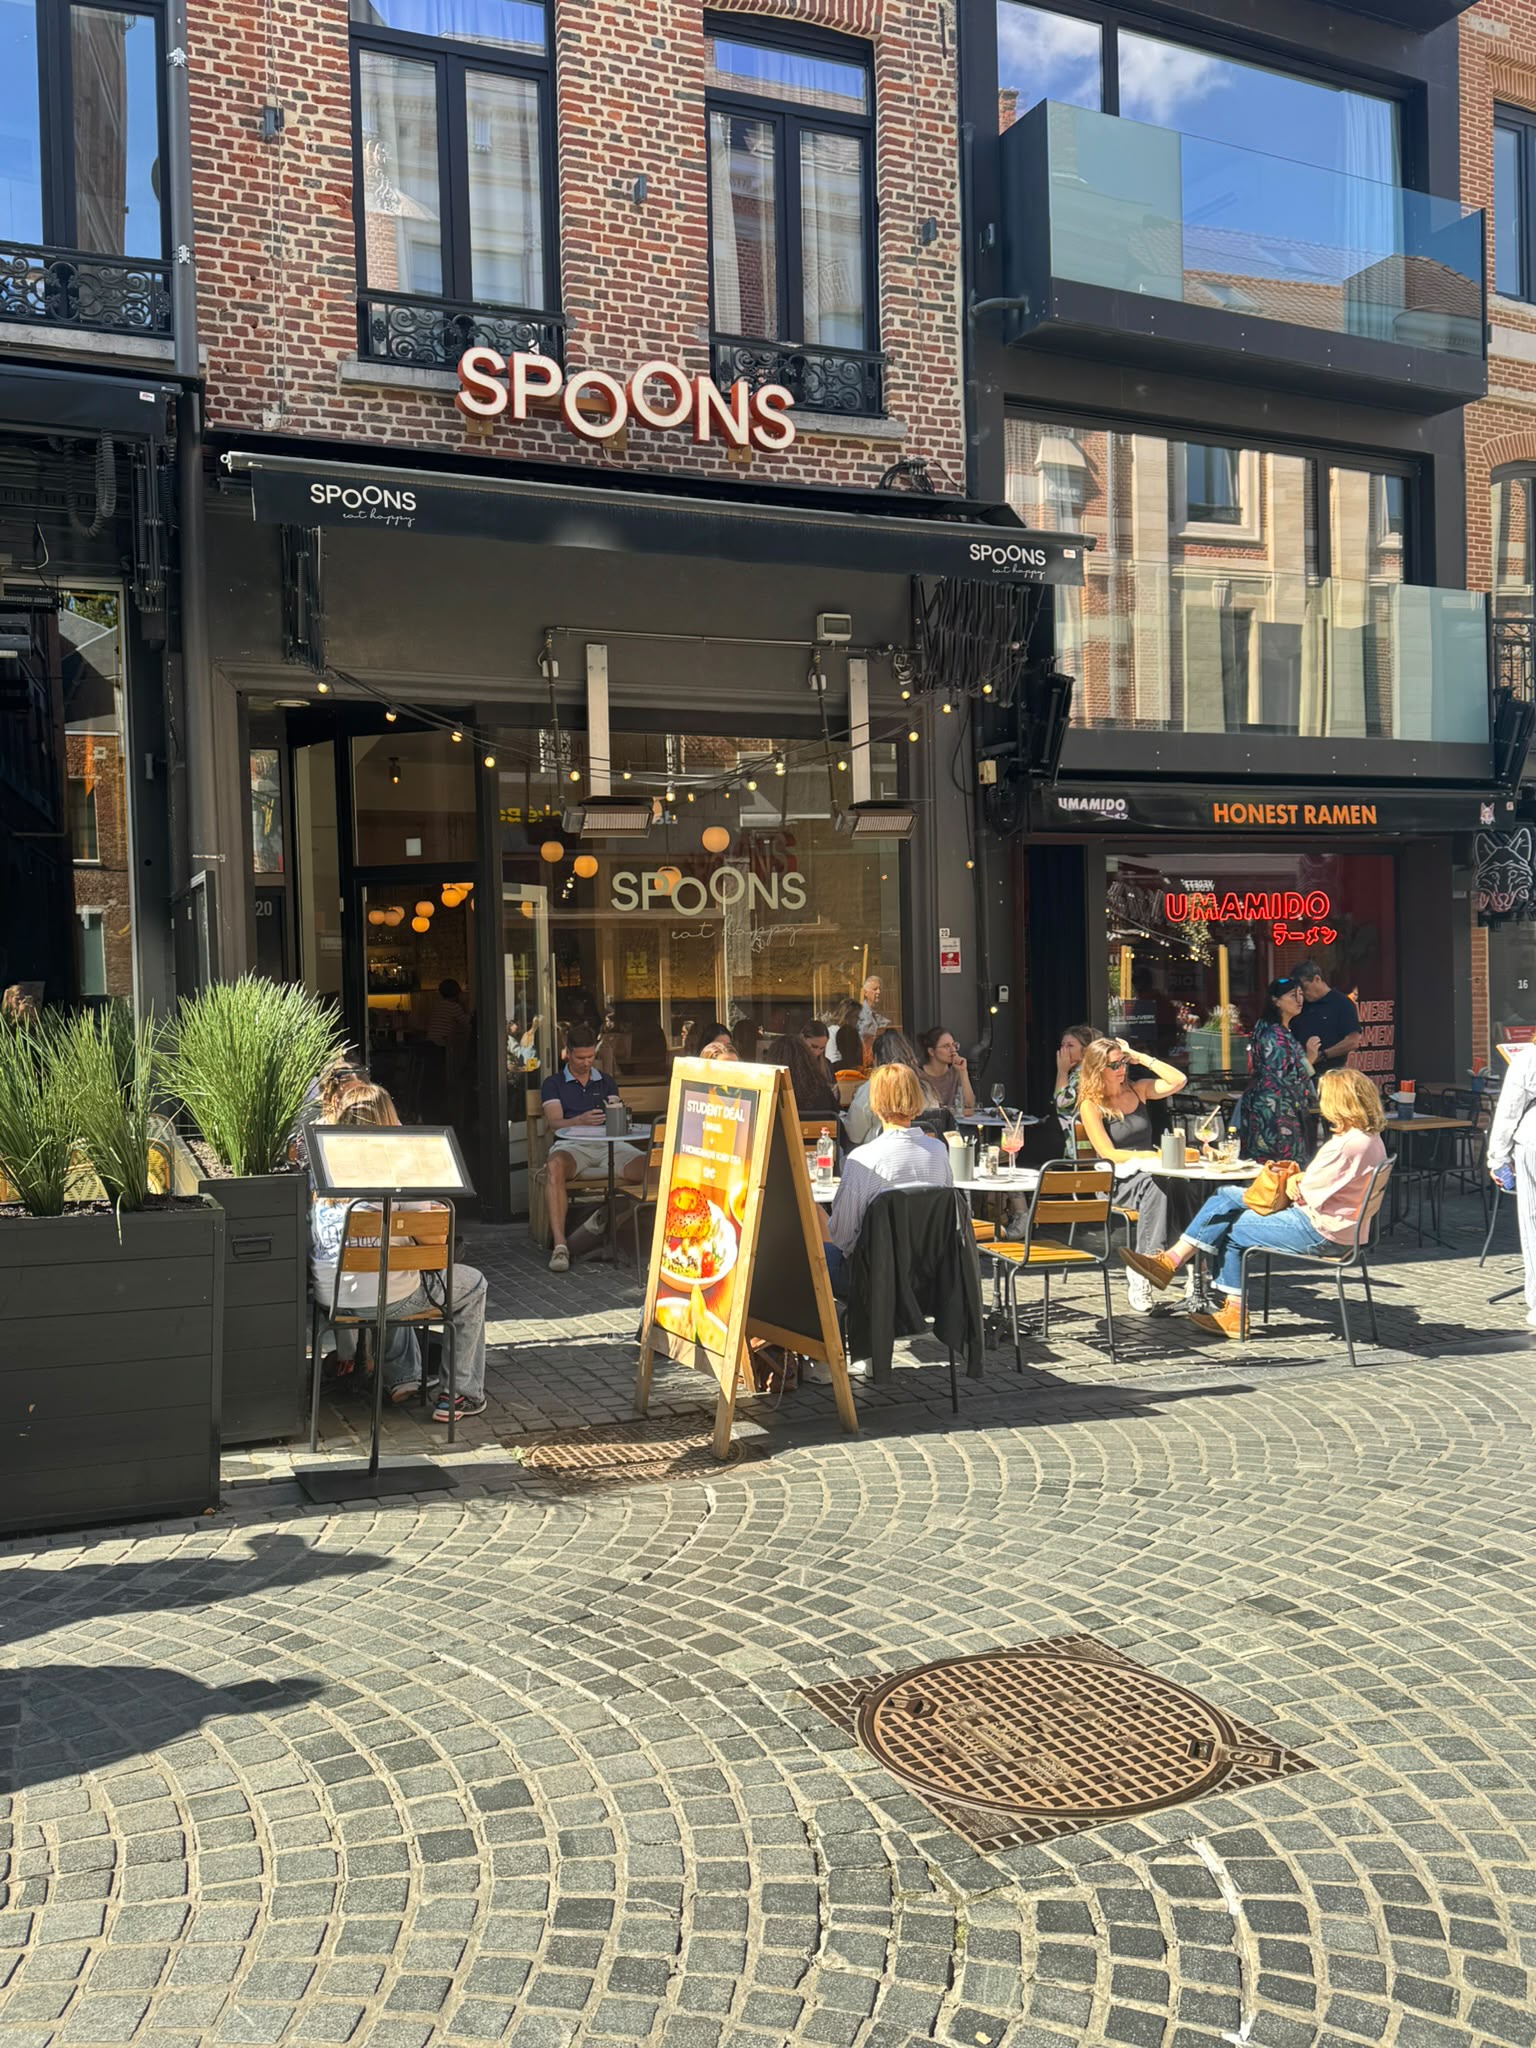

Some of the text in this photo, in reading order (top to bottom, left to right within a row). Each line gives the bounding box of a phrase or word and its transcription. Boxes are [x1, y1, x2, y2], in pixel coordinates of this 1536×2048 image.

[454, 346, 796, 453] SPOONS
[310, 483, 417, 511] SPOONS
[342, 507, 416, 528] eat happy
[969, 543, 1047, 566] SPOONS
[1057, 797, 1126, 811] UMAMIDO
[1212, 803, 1378, 825] HONEST RAMEN
[610, 866, 807, 916] SPOONS
[255, 900, 273, 917] 20
[1165, 890, 1331, 922] UMAMIDO
[671, 914, 805, 946] eat happy
[1272, 922, 1338, 946] ラーメン
[1517, 979, 1529, 990] 16
[1358, 1025, 1395, 1047] AMEN
[1345, 1049, 1395, 1072] ONBURI
[686, 1100, 745, 1123] STUDENT DEAL
